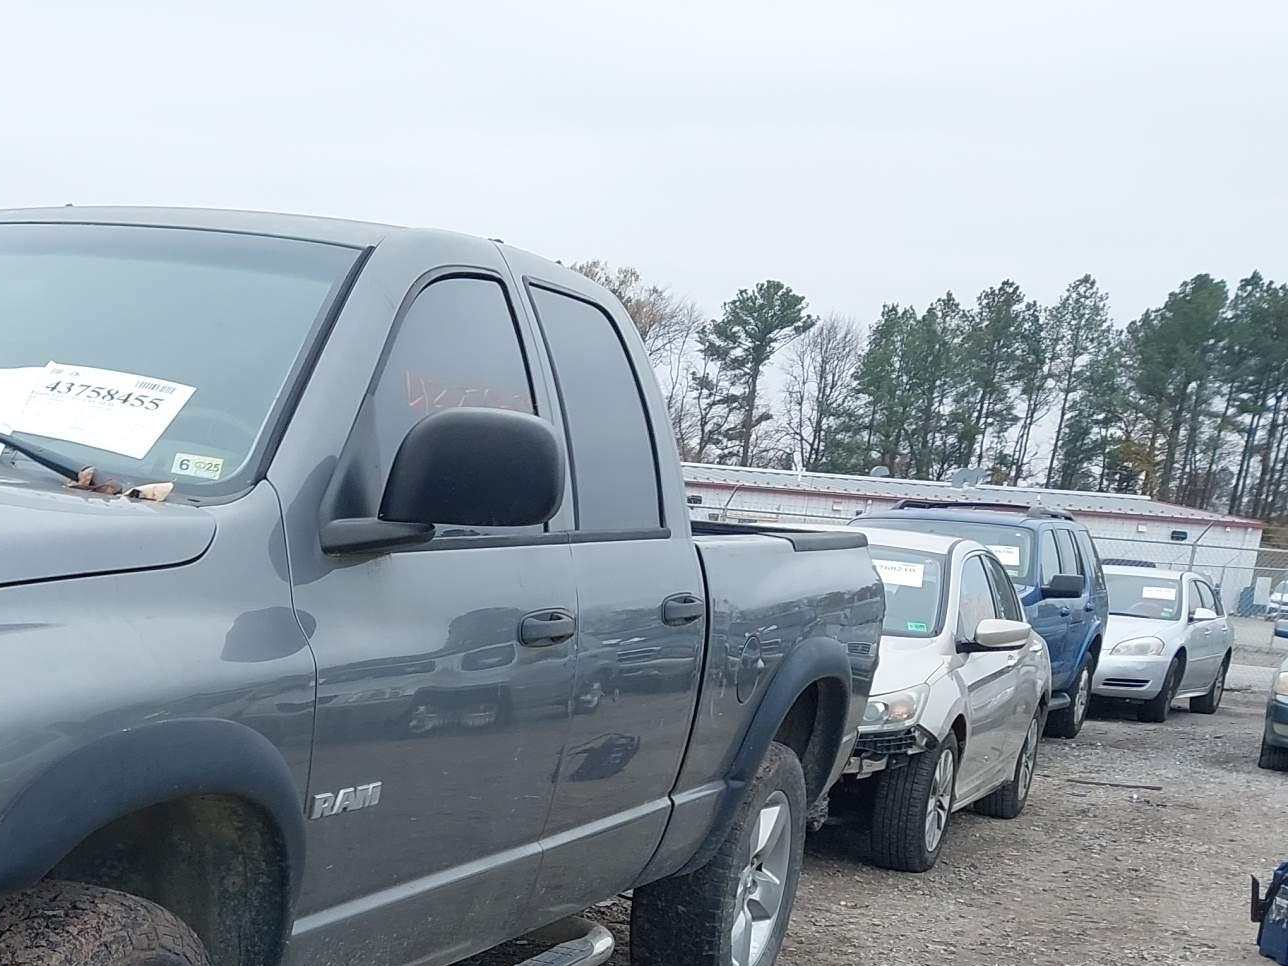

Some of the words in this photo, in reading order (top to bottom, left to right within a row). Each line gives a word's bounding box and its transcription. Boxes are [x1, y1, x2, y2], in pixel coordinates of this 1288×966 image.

[45, 380, 165, 410] 43758455
[179, 458, 190, 471] 6
[310, 781, 383, 820] RAM
